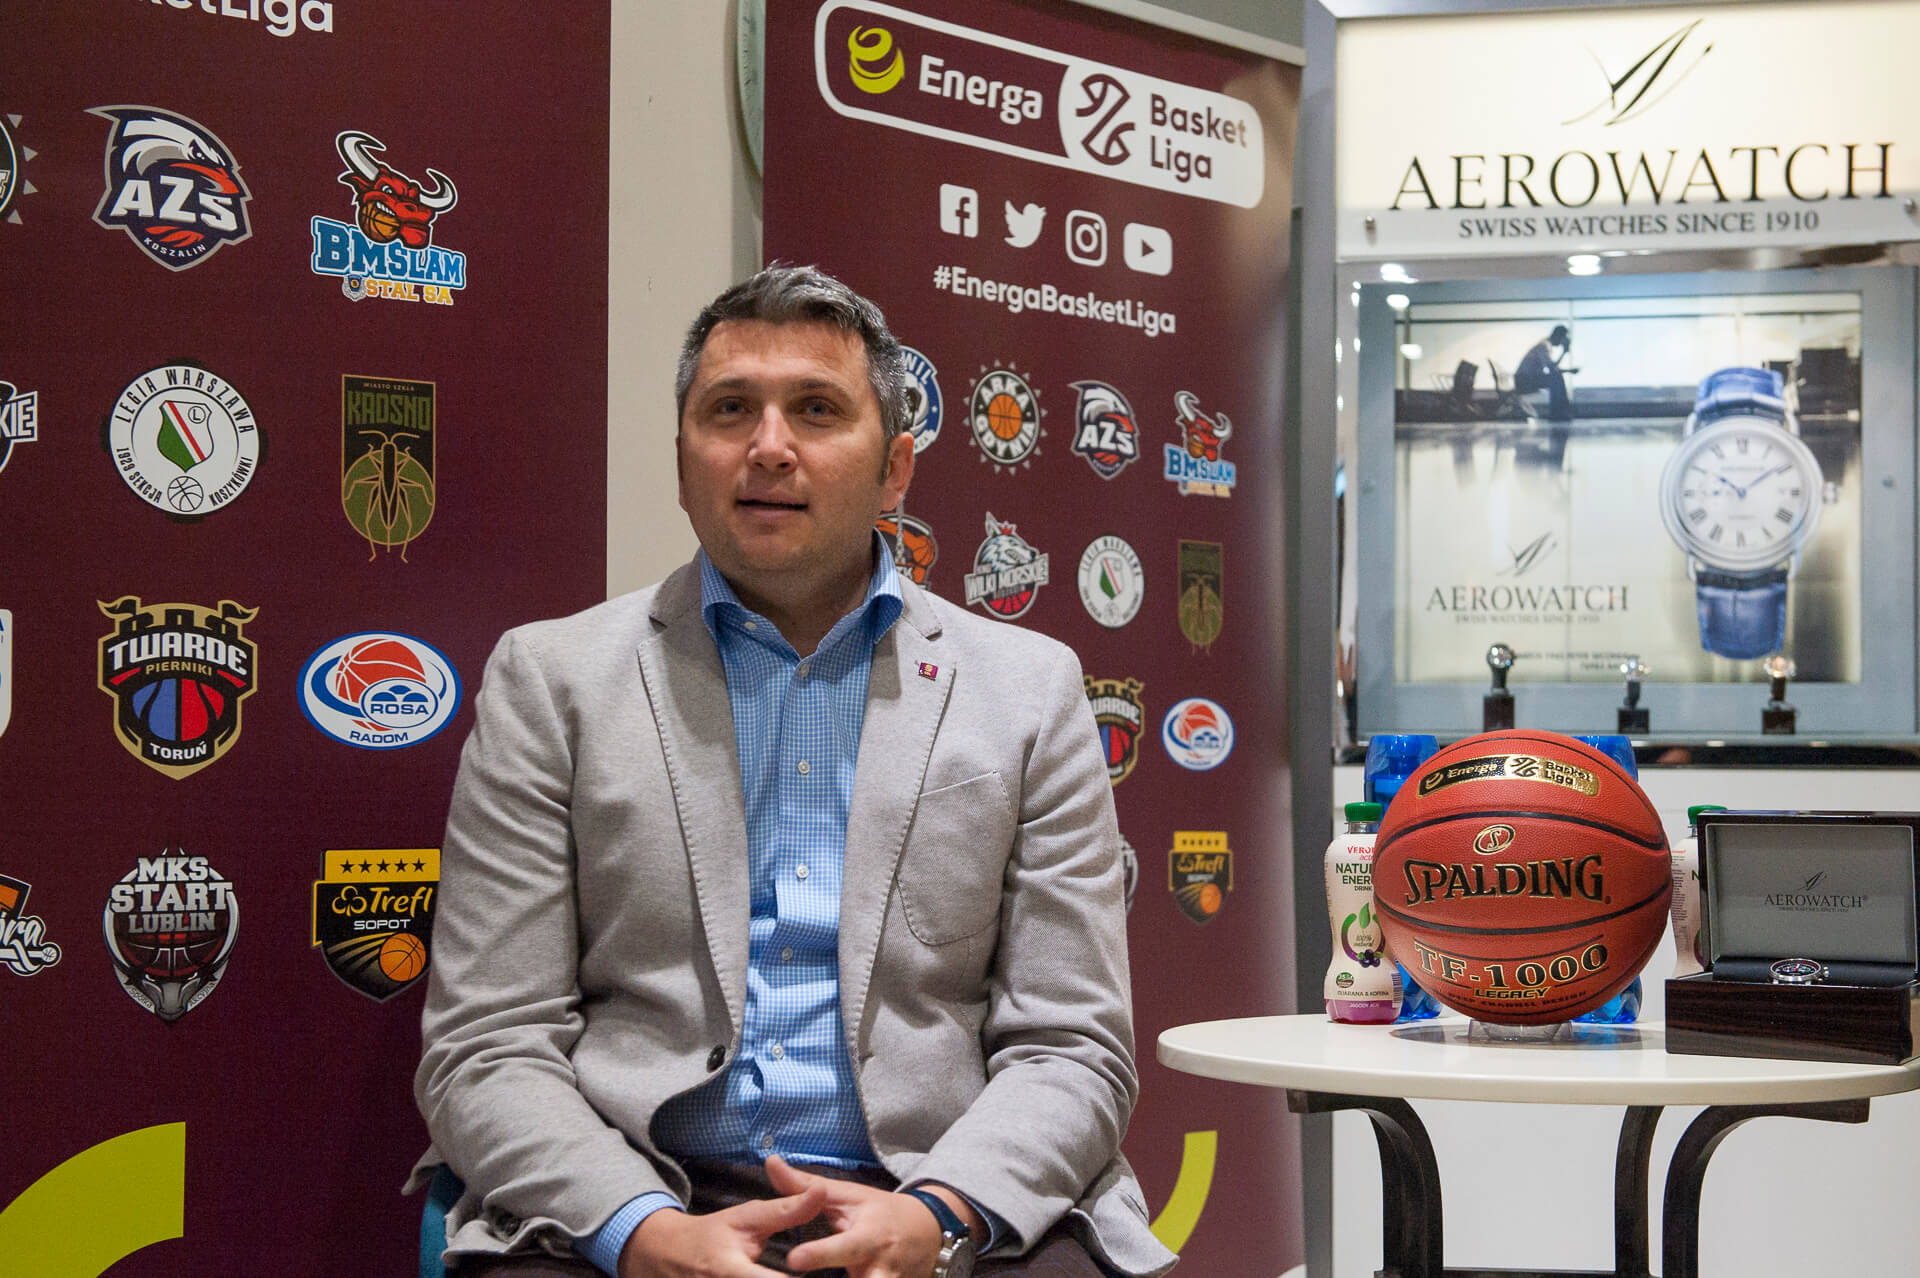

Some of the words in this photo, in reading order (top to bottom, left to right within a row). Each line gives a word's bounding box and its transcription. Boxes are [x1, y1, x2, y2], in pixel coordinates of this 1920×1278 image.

[919, 54, 1043, 125] Energa
[1150, 93, 1247, 148] Basket
[1149, 135, 1212, 182] Liga
[1389, 143, 1895, 210] AEROWATCH
[110, 175, 238, 232] AZS
[1459, 217, 1536, 239] SWISS
[1547, 215, 1667, 236] WATCHES
[1676, 213, 1756, 234] SINCE
[1765, 211, 1819, 232] 1910
[143, 237, 207, 258] KOSZALIN
[365, 279, 421, 302] STAL
[423, 285, 455, 306] SA
[932, 265, 1176, 338] #EnergaBasketLiga
[115, 377, 158, 423] LEGIA
[165, 368, 255, 434] WARSZAWA
[981, 376, 1030, 411] ARKA
[976, 414, 1036, 457] GDYNIA
[1078, 421, 1135, 455] AZS
[116, 448, 137, 472] 1929
[128, 471, 163, 504] SEKCJA
[208, 456, 253, 507] KOSZYKÓWKI
[1426, 585, 1629, 612] AEROWATCH
[108, 632, 248, 675] TWARDE
[145, 661, 212, 676] PIERNIKI
[370, 703, 429, 715] ROSA
[150, 741, 207, 760] TORUŃ
[349, 730, 409, 744] RADOM
[1449, 763, 1498, 779] Energa
[1544, 771, 1576, 786] Liga
[1545, 761, 1593, 782] Basket
[137, 856, 209, 882] MKS
[1403, 854, 1604, 907] SPALDING
[110, 882, 233, 913] START
[370, 886, 433, 918] Trefl
[128, 912, 217, 934] LUBLIN
[353, 919, 411, 930] SOPOT
[1414, 941, 1609, 988] TF-1000
[1473, 986, 1552, 1000] LEGACY
